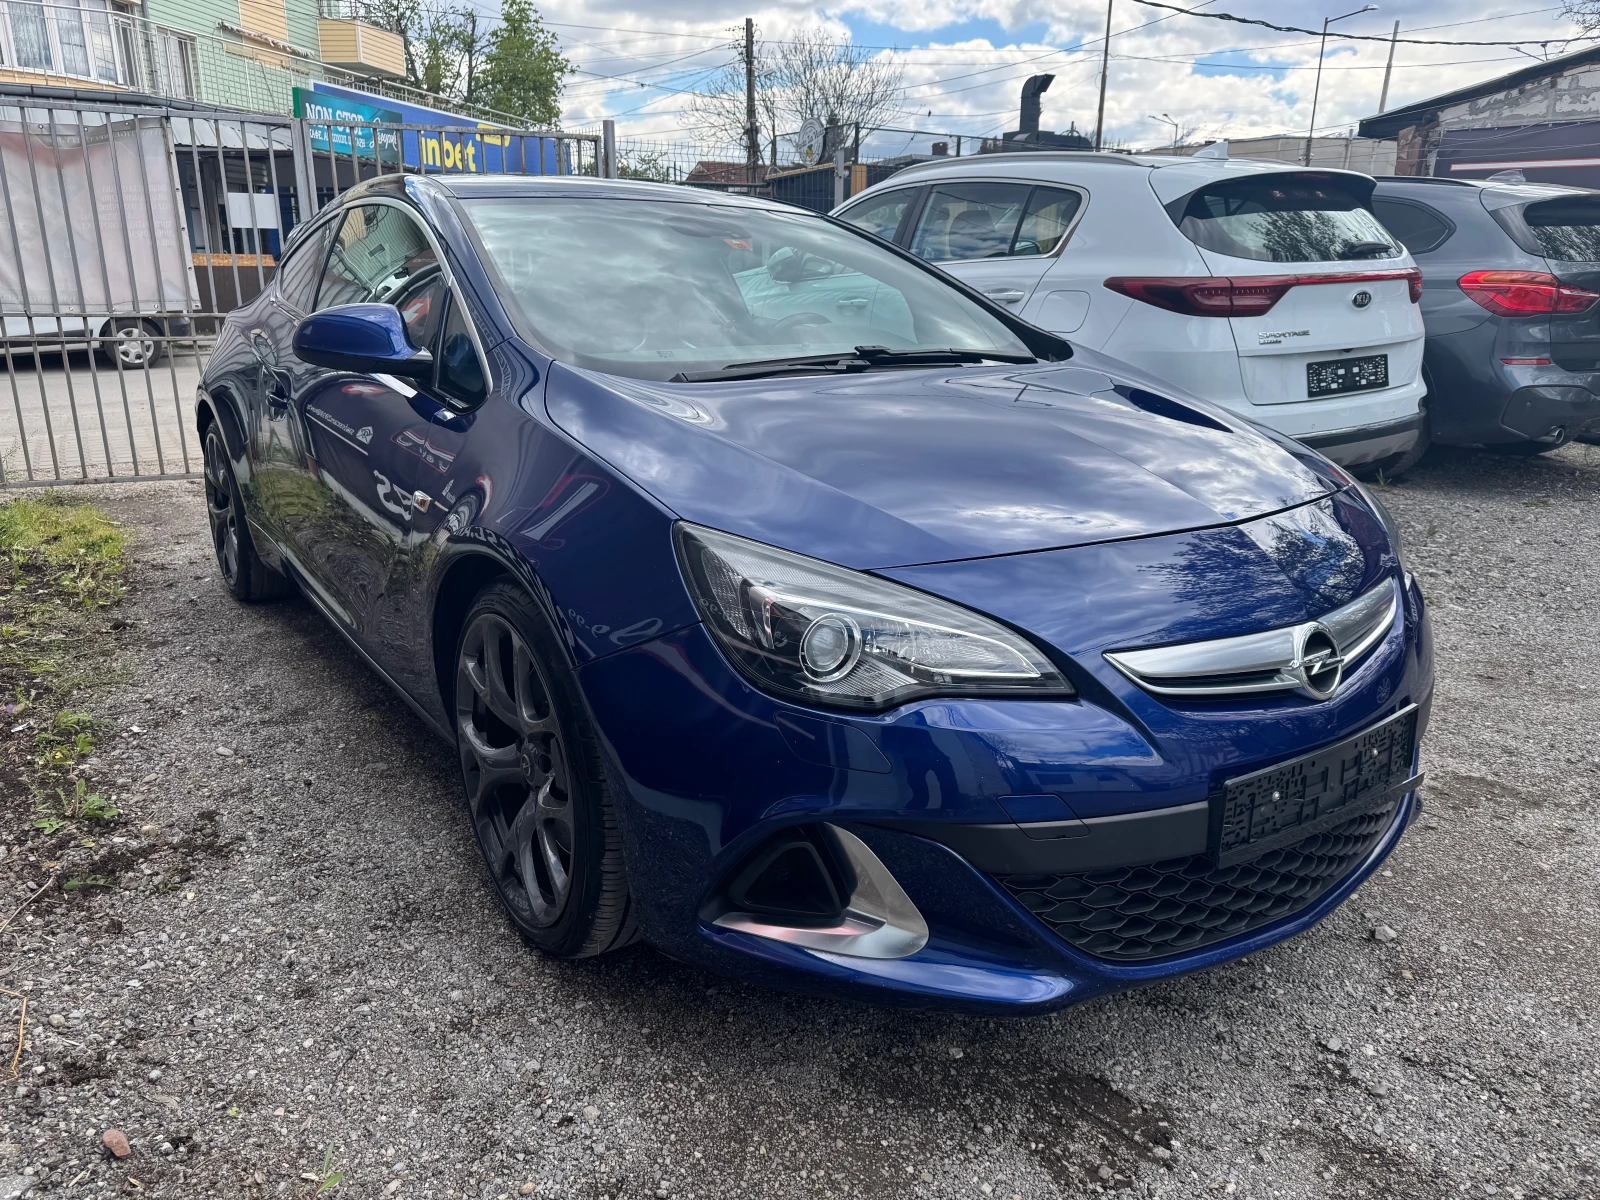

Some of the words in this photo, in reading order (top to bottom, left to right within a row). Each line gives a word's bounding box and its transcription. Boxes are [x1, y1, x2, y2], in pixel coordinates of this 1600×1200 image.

[305, 102, 332, 128] NON
[335, 109, 364, 136] STOP
[420, 131, 476, 172] inbet
[1356, 294, 1370, 305] KIA
